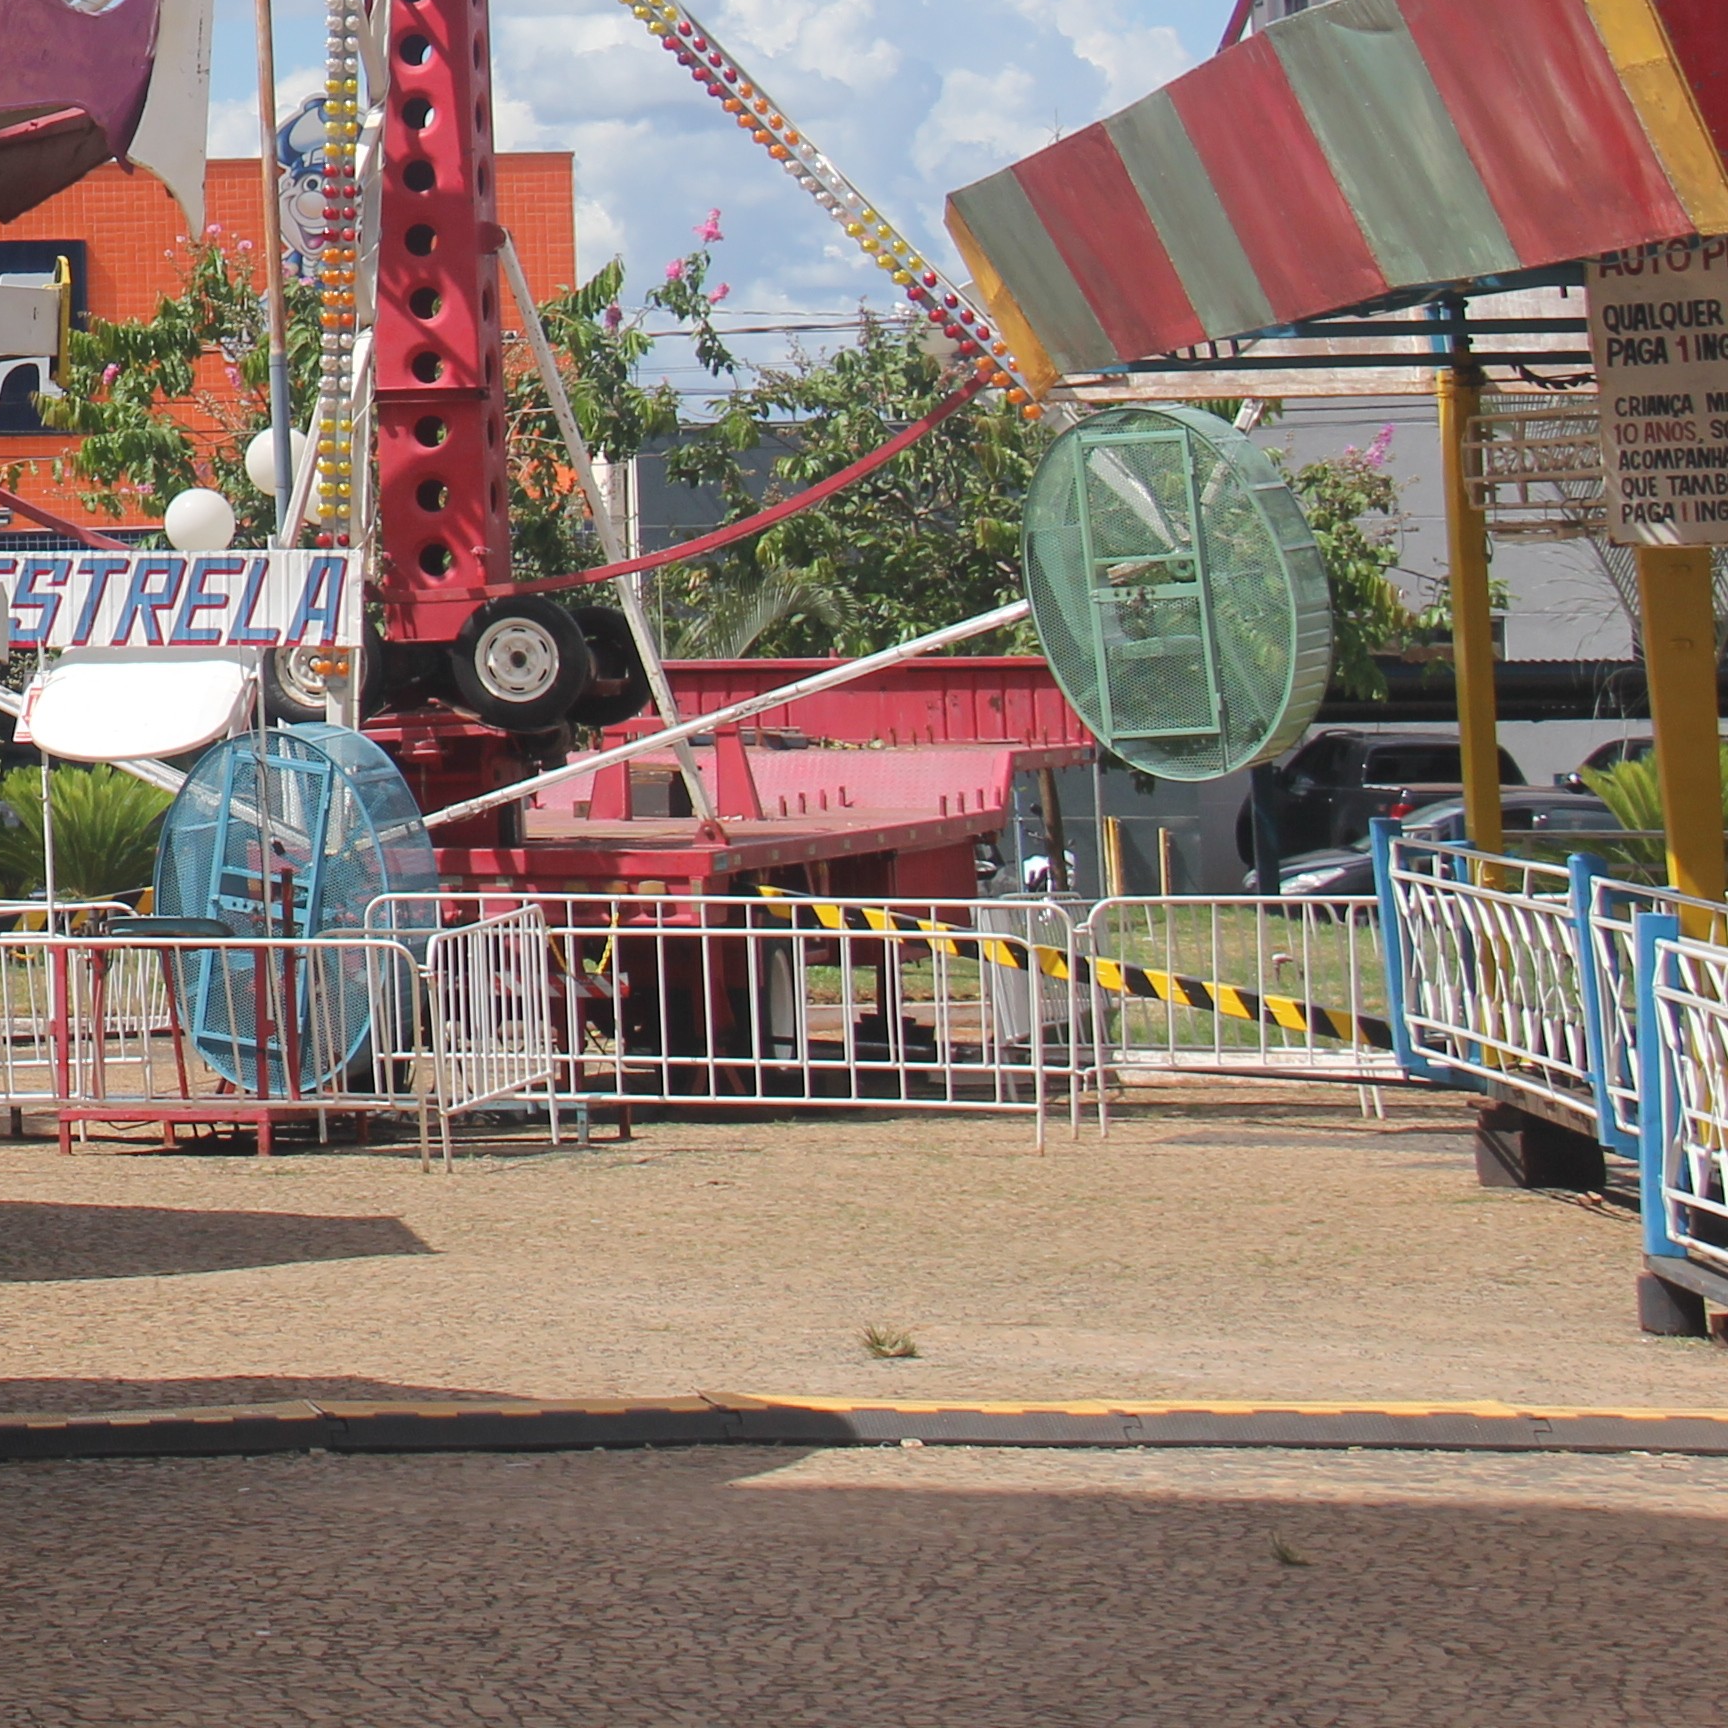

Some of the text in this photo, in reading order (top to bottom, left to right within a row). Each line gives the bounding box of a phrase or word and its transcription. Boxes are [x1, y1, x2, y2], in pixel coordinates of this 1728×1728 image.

[1702, 235, 1728, 271] P
[1603, 299, 1725, 335] QUALQUER
[1606, 336, 1669, 367] PAGA
[1675, 335, 1689, 363] 1
[1614, 393, 1694, 418] CRIANÇA
[1614, 422, 1638, 445] 10
[1710, 419, 1728, 439] S
[1621, 473, 1728, 500] QUE TAMB
[1621, 501, 1675, 523] PAGA
